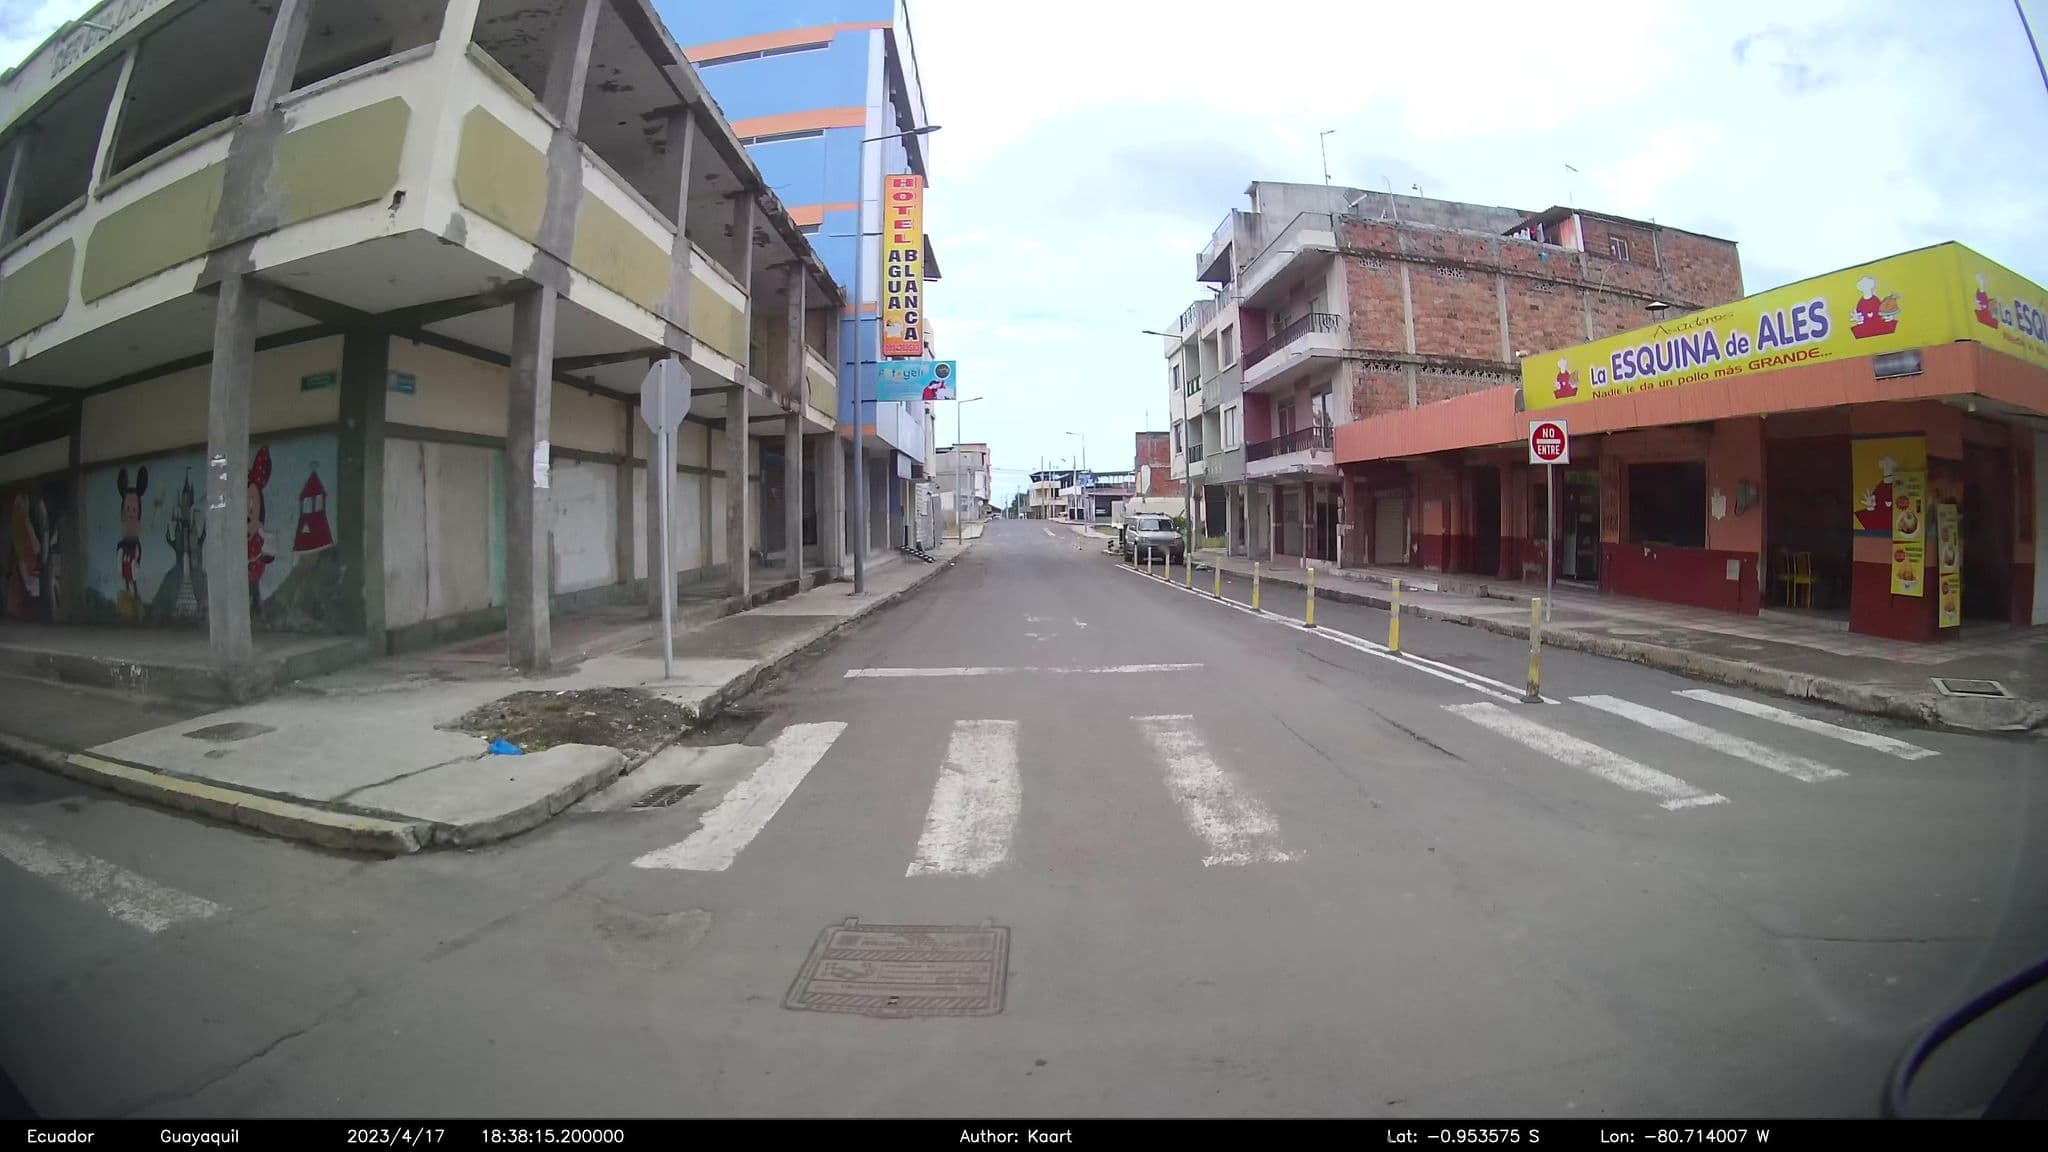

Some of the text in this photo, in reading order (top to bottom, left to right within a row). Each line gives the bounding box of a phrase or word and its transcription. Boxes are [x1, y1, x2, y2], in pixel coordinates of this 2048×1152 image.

[892, 178, 917, 244] HOTEL
[888, 250, 901, 310] AGUA
[904, 250, 918, 341] BLANCA
[1591, 301, 1829, 385] La ESQUINA de ALES
[1592, 388, 1621, 399] Nadie
[1640, 382, 1654, 391] da
[1659, 379, 1673, 387] un
[1678, 371, 1709, 386] pollo
[1715, 365, 1743, 378] más
[1748, 347, 1833, 370] GRANDE...
[1537, 444, 1561, 455] ENTRE
[1542, 428, 1555, 438] NO
